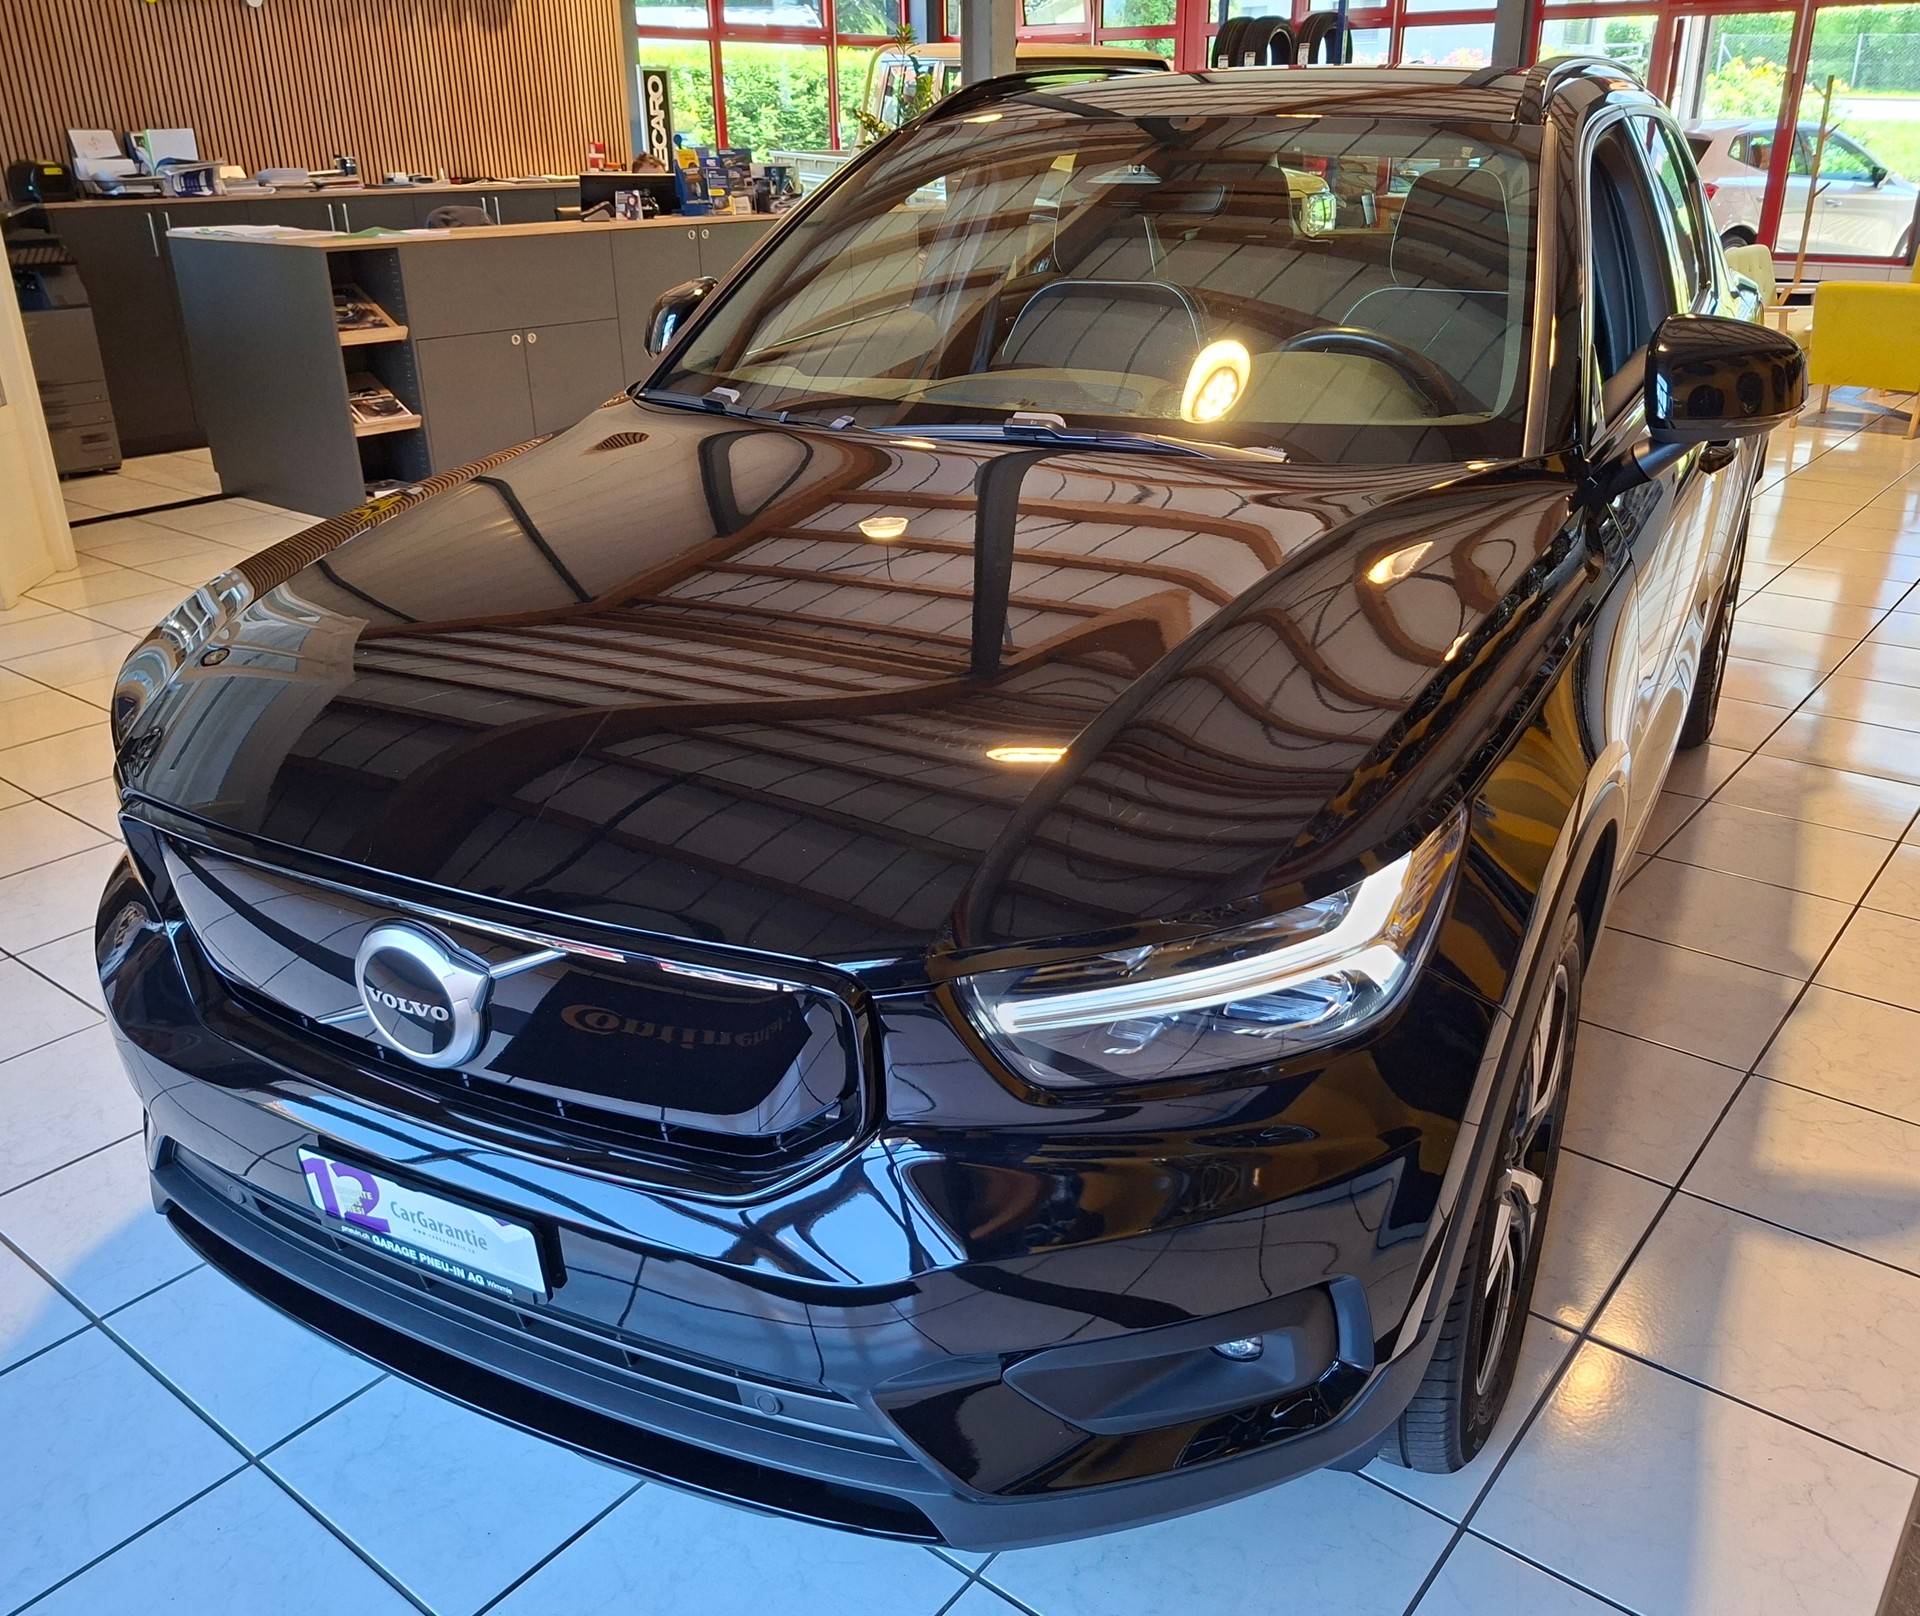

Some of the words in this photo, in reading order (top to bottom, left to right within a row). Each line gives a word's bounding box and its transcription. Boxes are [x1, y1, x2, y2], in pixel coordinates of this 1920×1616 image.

[647, 75, 669, 171] ECARO
[365, 984, 449, 1021] VOLVO
[302, 1157, 391, 1234] 12
[390, 1201, 488, 1250] CarGarantie
[371, 1235, 417, 1260] GARAGE
[419, 1252, 465, 1279] PNEU-IN
[467, 1271, 485, 1286] AG
